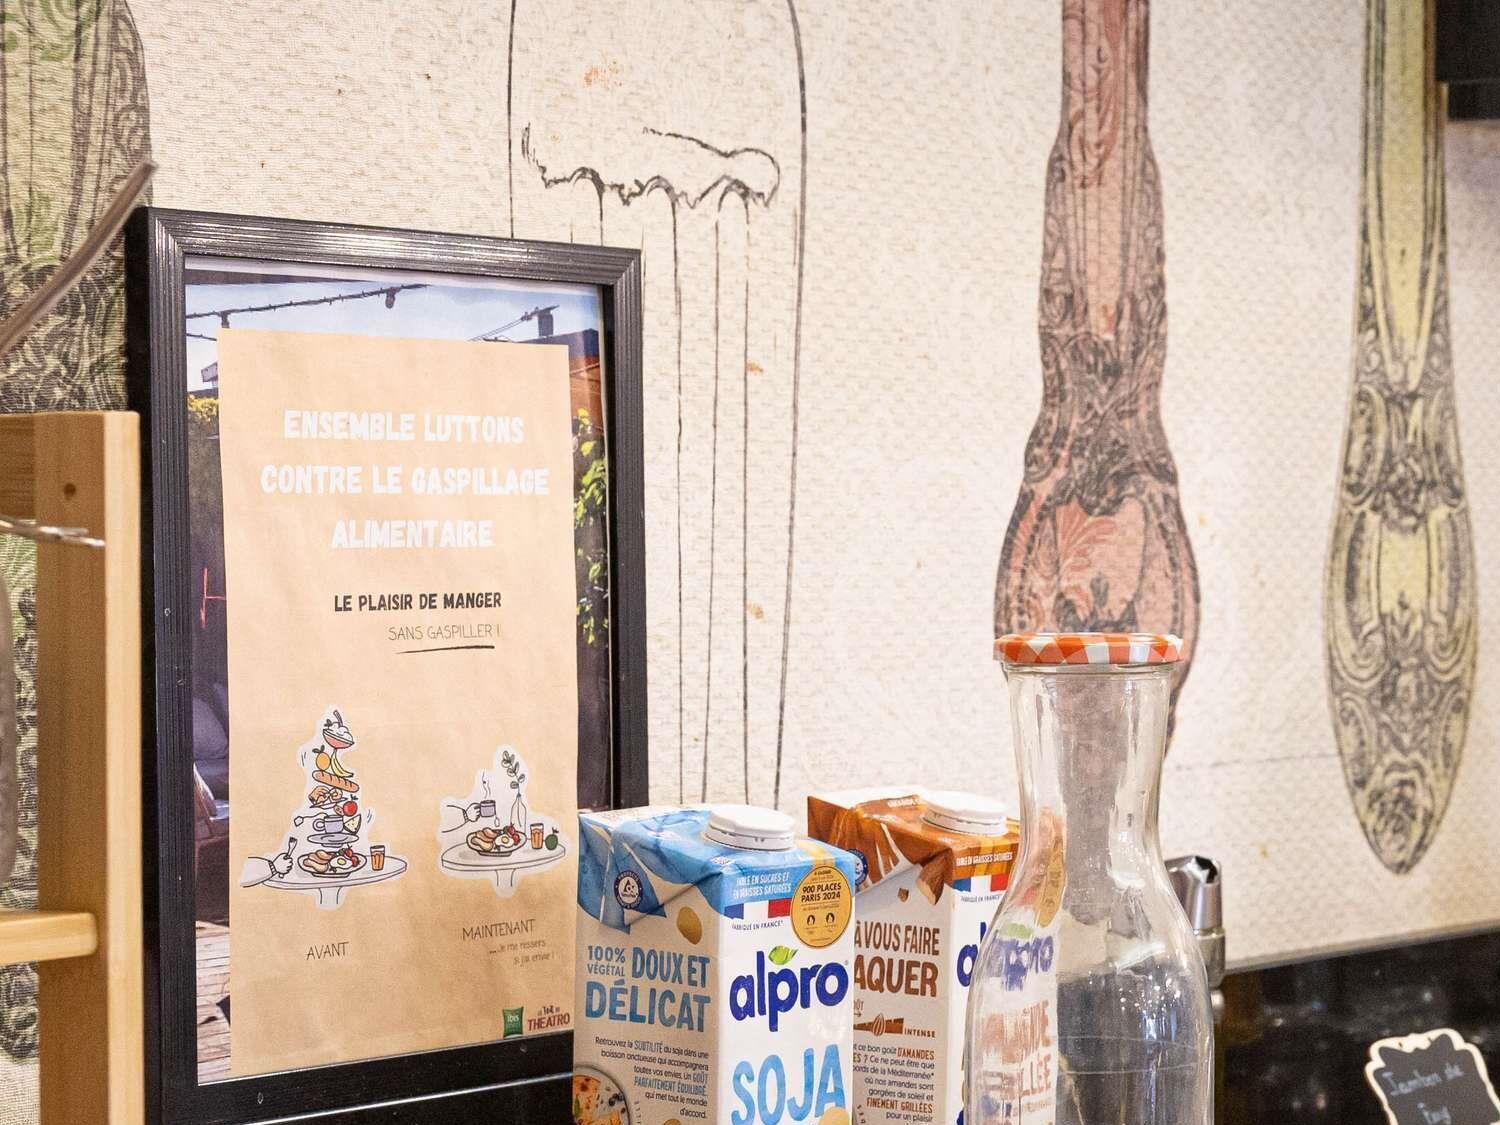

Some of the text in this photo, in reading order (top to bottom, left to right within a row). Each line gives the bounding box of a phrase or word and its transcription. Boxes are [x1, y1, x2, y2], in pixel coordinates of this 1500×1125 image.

[284, 410, 526, 444] ENSEMBLE LUTTONS
[260, 464, 549, 495] CONTRE LE GASPILLAGE
[331, 519, 494, 549] ALIMENTAIRE
[334, 592, 501, 611] LE PLAISIR DE MANGER
[388, 624, 493, 640] SANS GASPILLER
[802, 882, 841, 894] 900 PLACES
[801, 891, 841, 903] PARIS 2024
[462, 919, 537, 940] MAINTENANT
[864, 921, 901, 951] VOUS
[904, 925, 940, 956] FAIRE
[304, 941, 350, 960] AVANT
[587, 945, 625, 963] 100%
[587, 961, 625, 977] VÉGÉTAL
[631, 946, 711, 988] DOUX ET
[729, 951, 849, 1032] alpro
[585, 979, 711, 1032] DÉLICAT
[527, 1012, 571, 1031] THEATRO
[904, 1027, 936, 1038] INTENSE
[601, 1050, 625, 1059] boisson
[658, 1056, 667, 1066] qui
[869, 1054, 879, 1063] Ce
[920, 1061, 935, 1070] que
[634, 1065, 651, 1075] toutes
[653, 1068, 663, 1076] vos
[869, 1065, 879, 1074] de
[888, 1079, 918, 1090] amandes
[645, 1090, 655, 1100] qui
[866, 1097, 898, 1110] FINEMENT
[886, 1111, 902, 1121] pour
[903, 1113, 911, 1121] un
